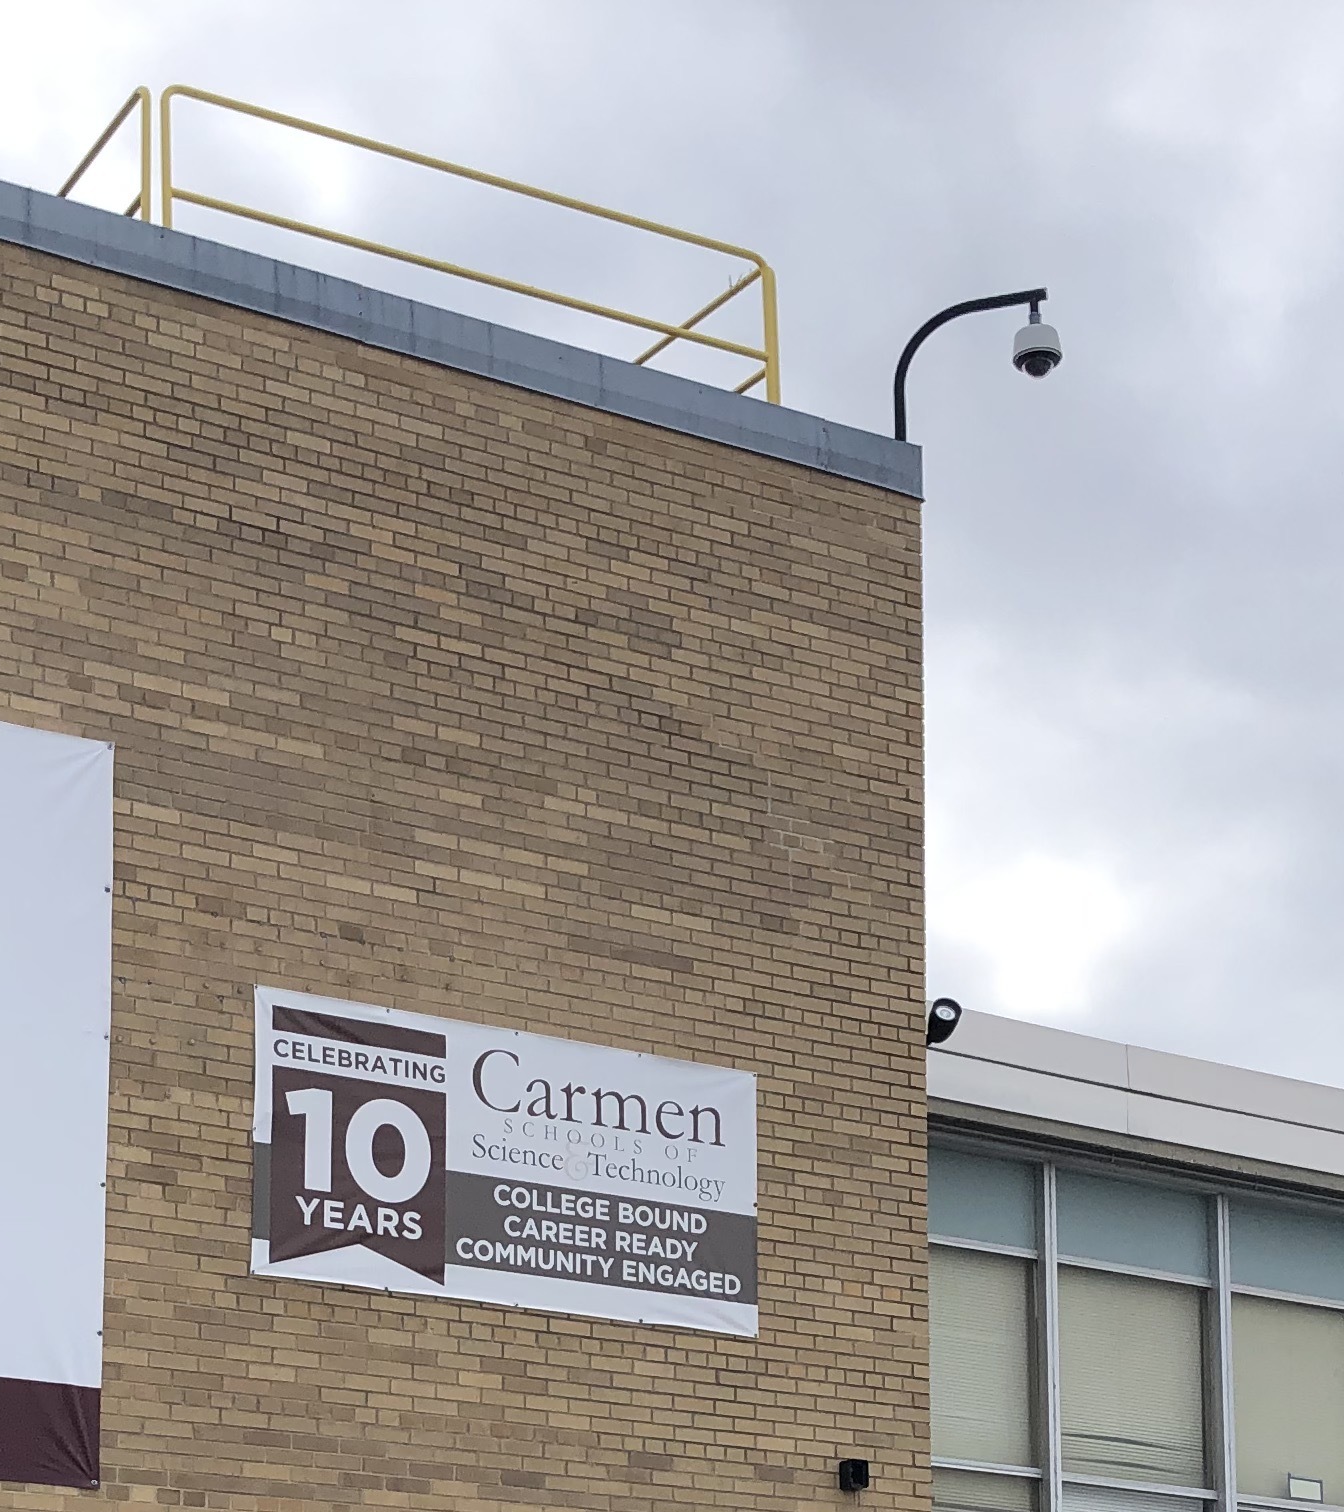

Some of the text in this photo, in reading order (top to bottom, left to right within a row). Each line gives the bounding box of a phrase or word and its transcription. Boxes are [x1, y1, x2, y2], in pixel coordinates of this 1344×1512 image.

[273, 1038, 446, 1084] CELEBRATING
[472, 1048, 726, 1147] Carmen
[285, 1087, 432, 1203] 10
[503, 1118, 698, 1163] SCHOOLS OF
[472, 1133, 564, 1171] Science
[588, 1152, 726, 1202] Technology
[295, 1195, 423, 1240] YEARS
[493, 1183, 707, 1236] COLLEGE BOUND
[504, 1215, 699, 1263] CAREER READY
[456, 1237, 741, 1296] COMMUNITY ENGAGED
